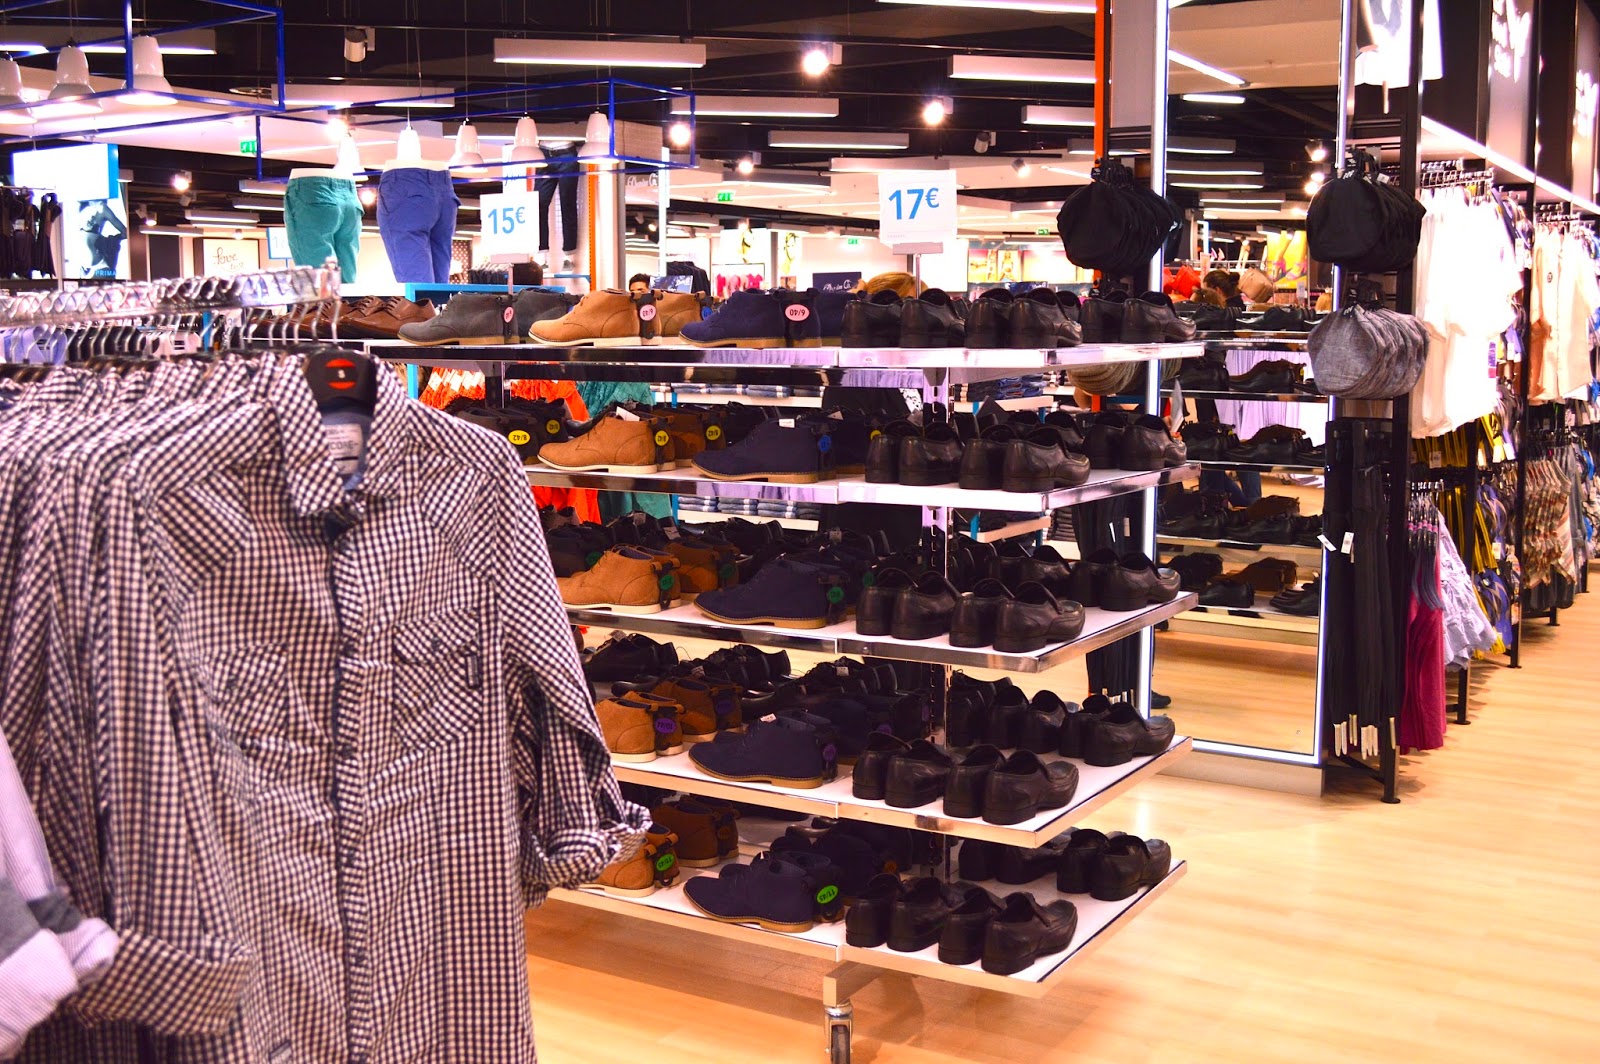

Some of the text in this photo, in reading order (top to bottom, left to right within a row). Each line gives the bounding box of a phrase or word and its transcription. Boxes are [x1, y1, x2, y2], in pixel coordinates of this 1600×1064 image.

[888, 187, 940, 220] 17€
[487, 206, 526, 235] 15€
[789, 308, 806, 318] 6/40
[819, 888, 835, 901] 11/45
